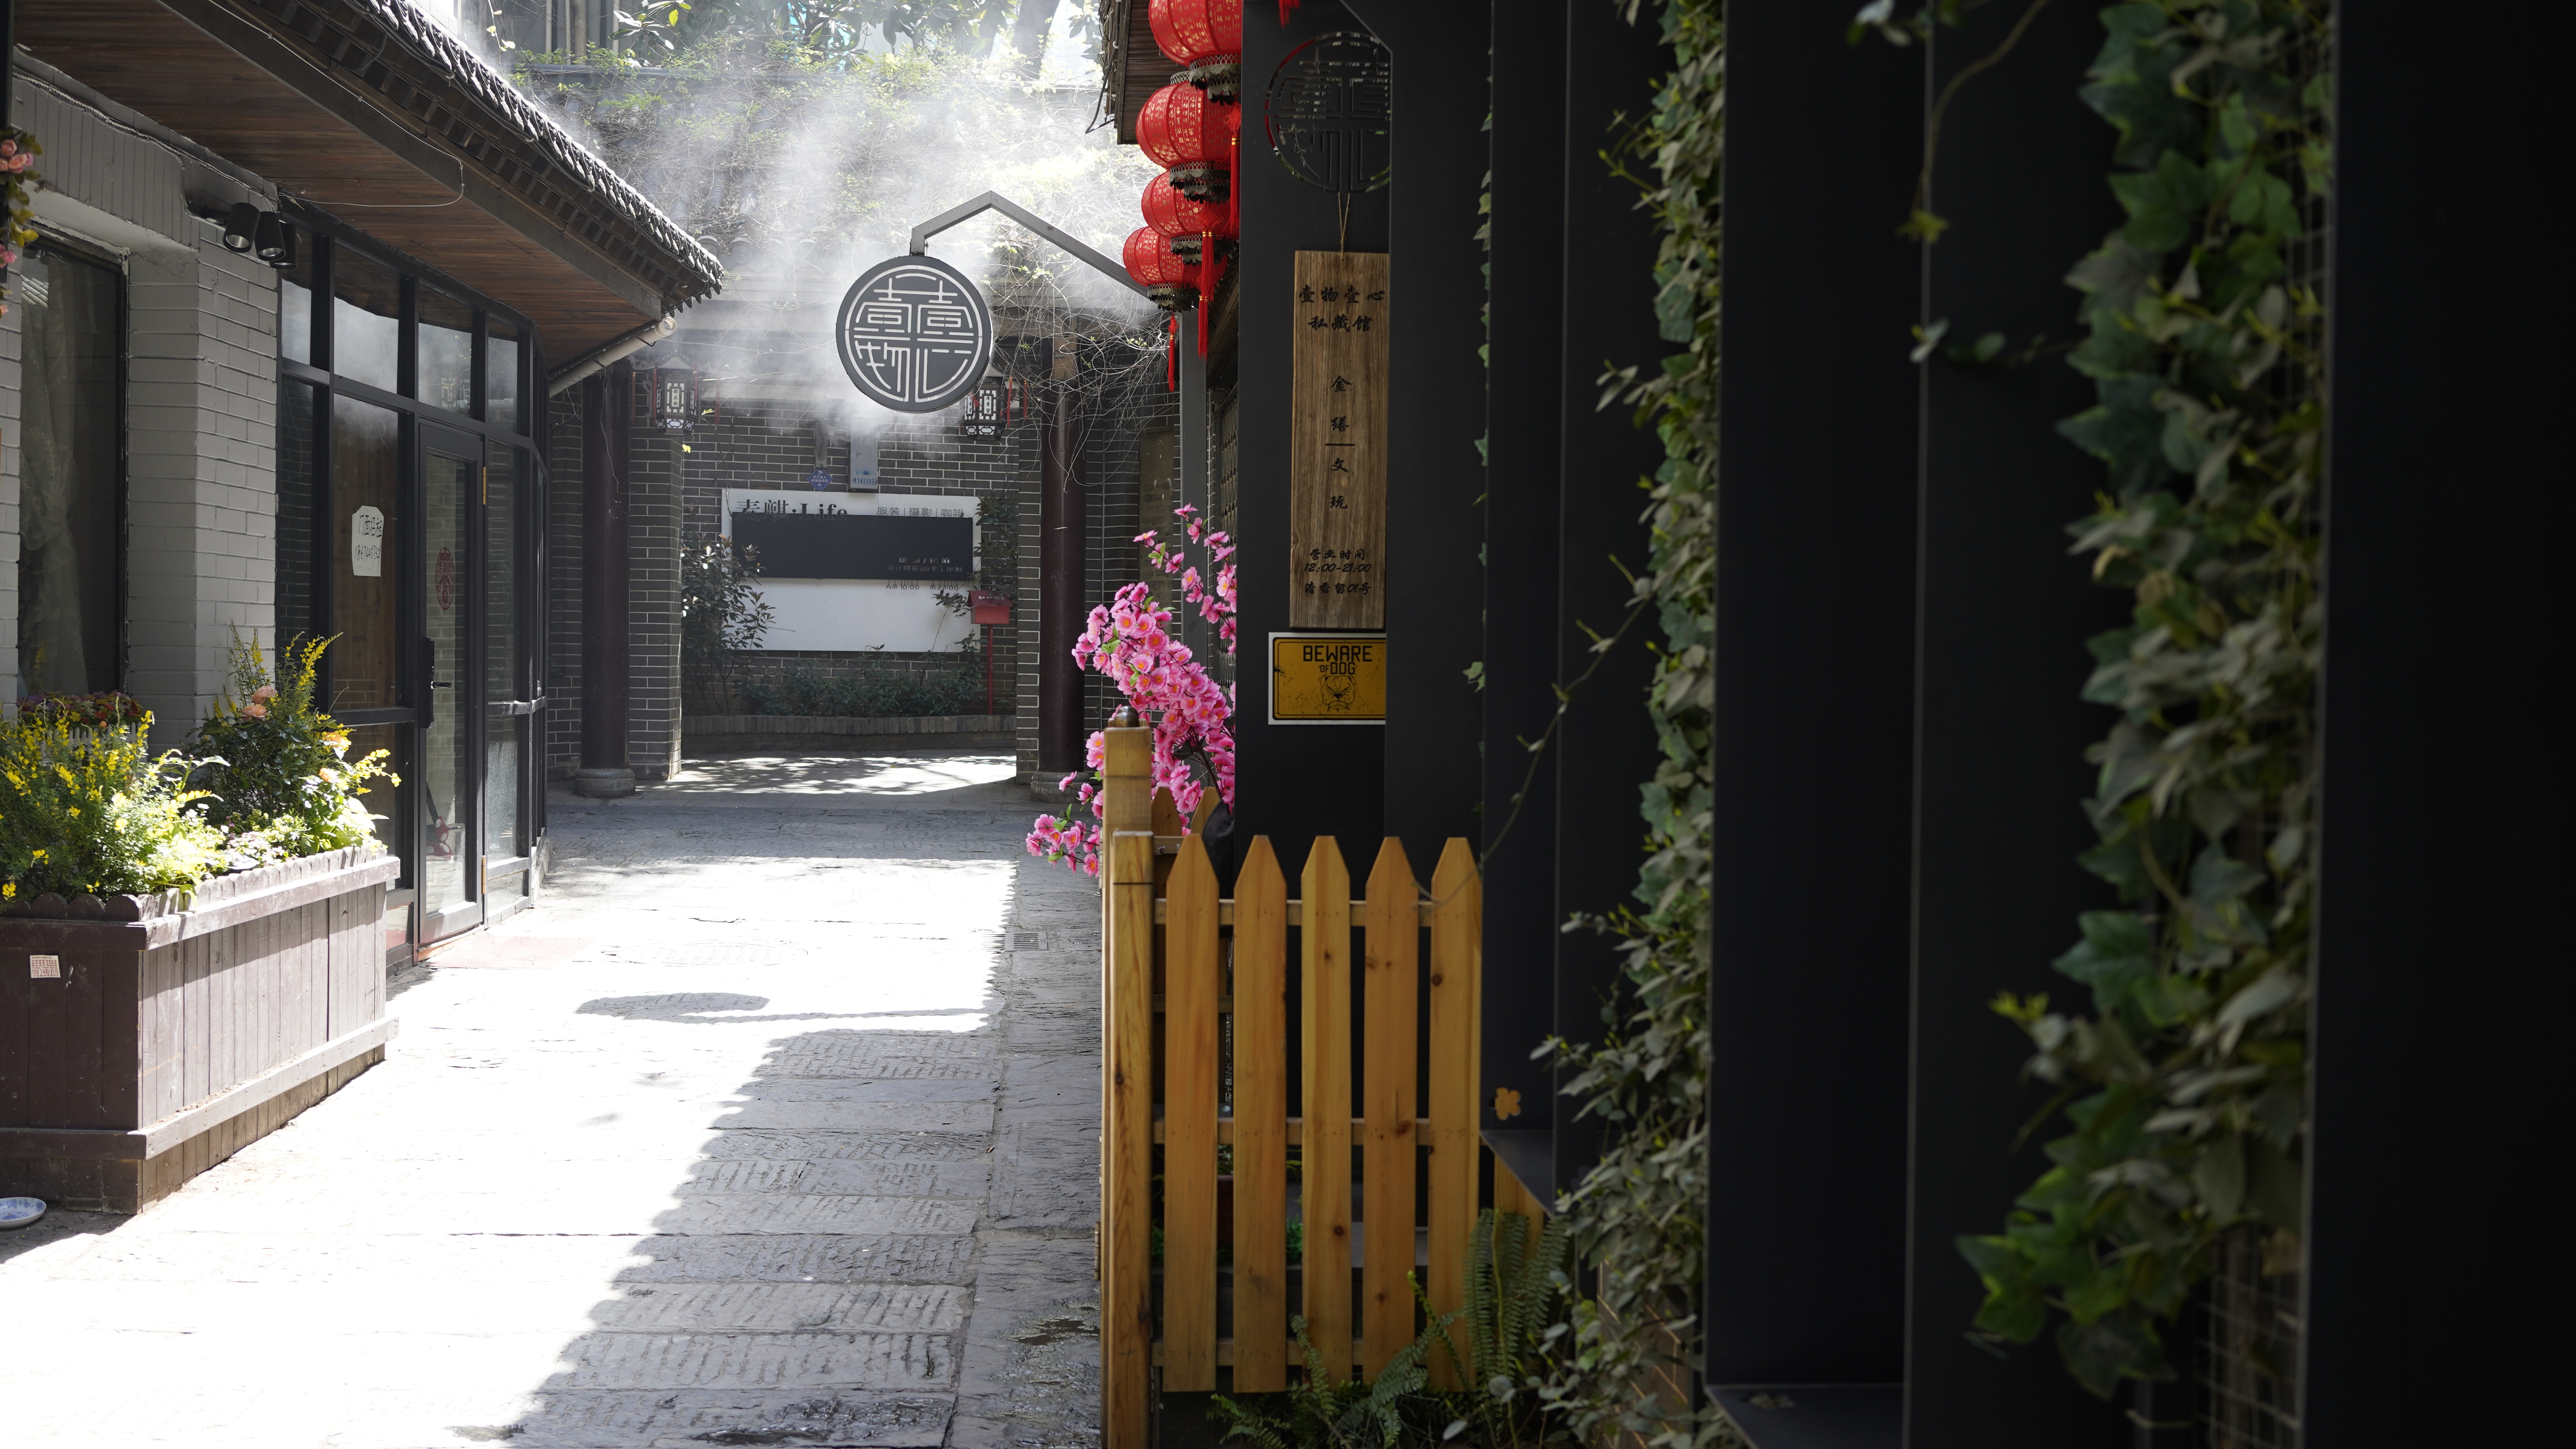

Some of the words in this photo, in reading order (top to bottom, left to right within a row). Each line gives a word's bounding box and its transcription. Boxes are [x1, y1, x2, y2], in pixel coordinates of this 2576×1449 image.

[1299, 285, 1385, 303] 壹物壹心
[1308, 313, 1373, 332] 私藏馆
[1310, 548, 1364, 560] 营业时间
[1305, 563, 1371, 573] 12:00-21:00
[1303, 646, 1372, 662] BEWARE
[1331, 662, 1355, 674] DOG
